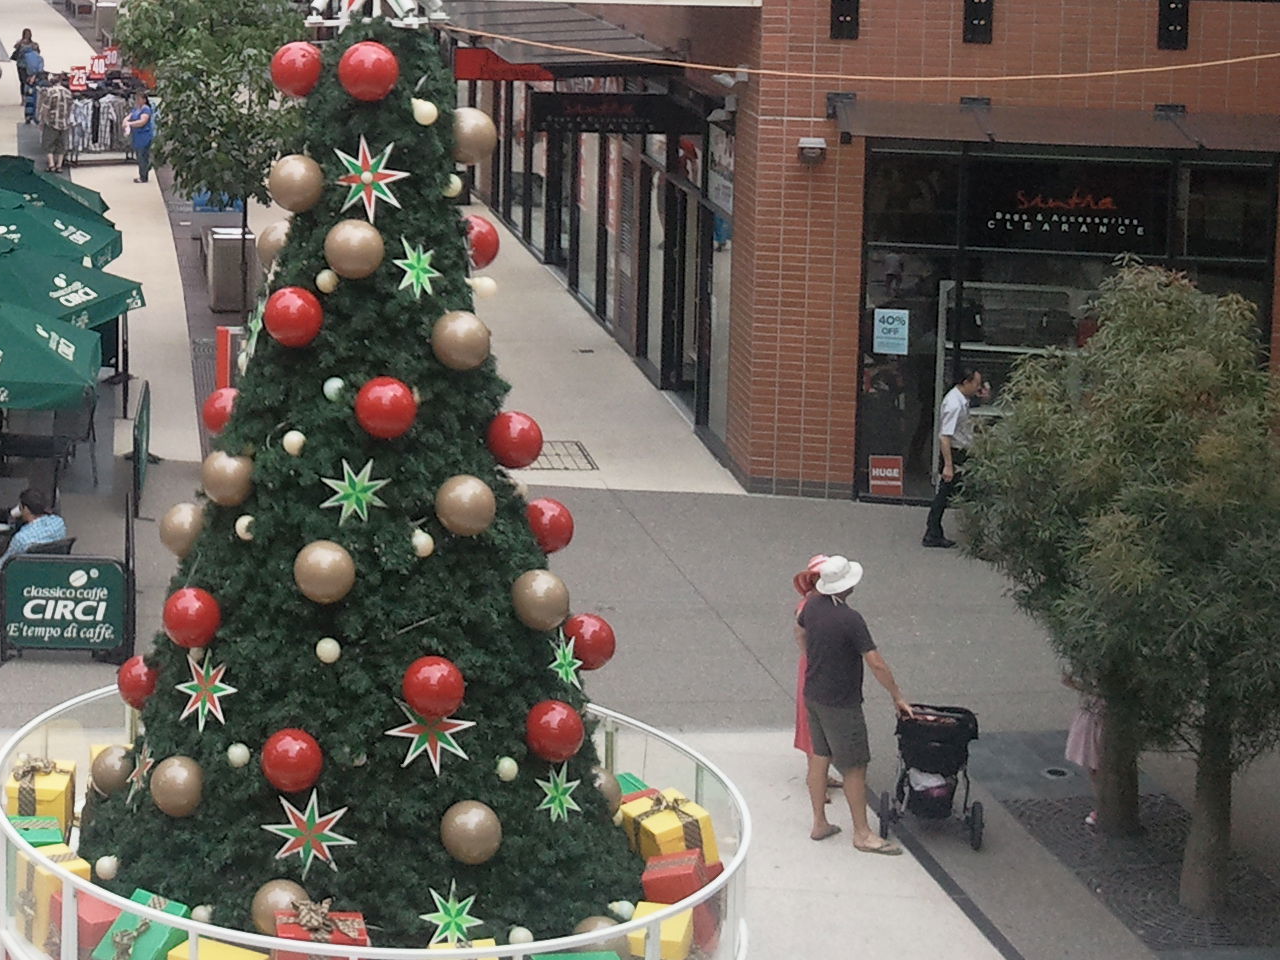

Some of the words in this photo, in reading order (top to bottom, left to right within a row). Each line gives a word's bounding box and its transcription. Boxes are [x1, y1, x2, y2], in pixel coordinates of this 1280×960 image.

[987, 219, 1145, 235] CLEARANCE
[878, 315, 906, 327] 40%
[871, 467, 901, 478] HUGE
[23, 585, 75, 598] classico
[22, 598, 108, 621] CIRCI
[63, 622, 77, 639] di
